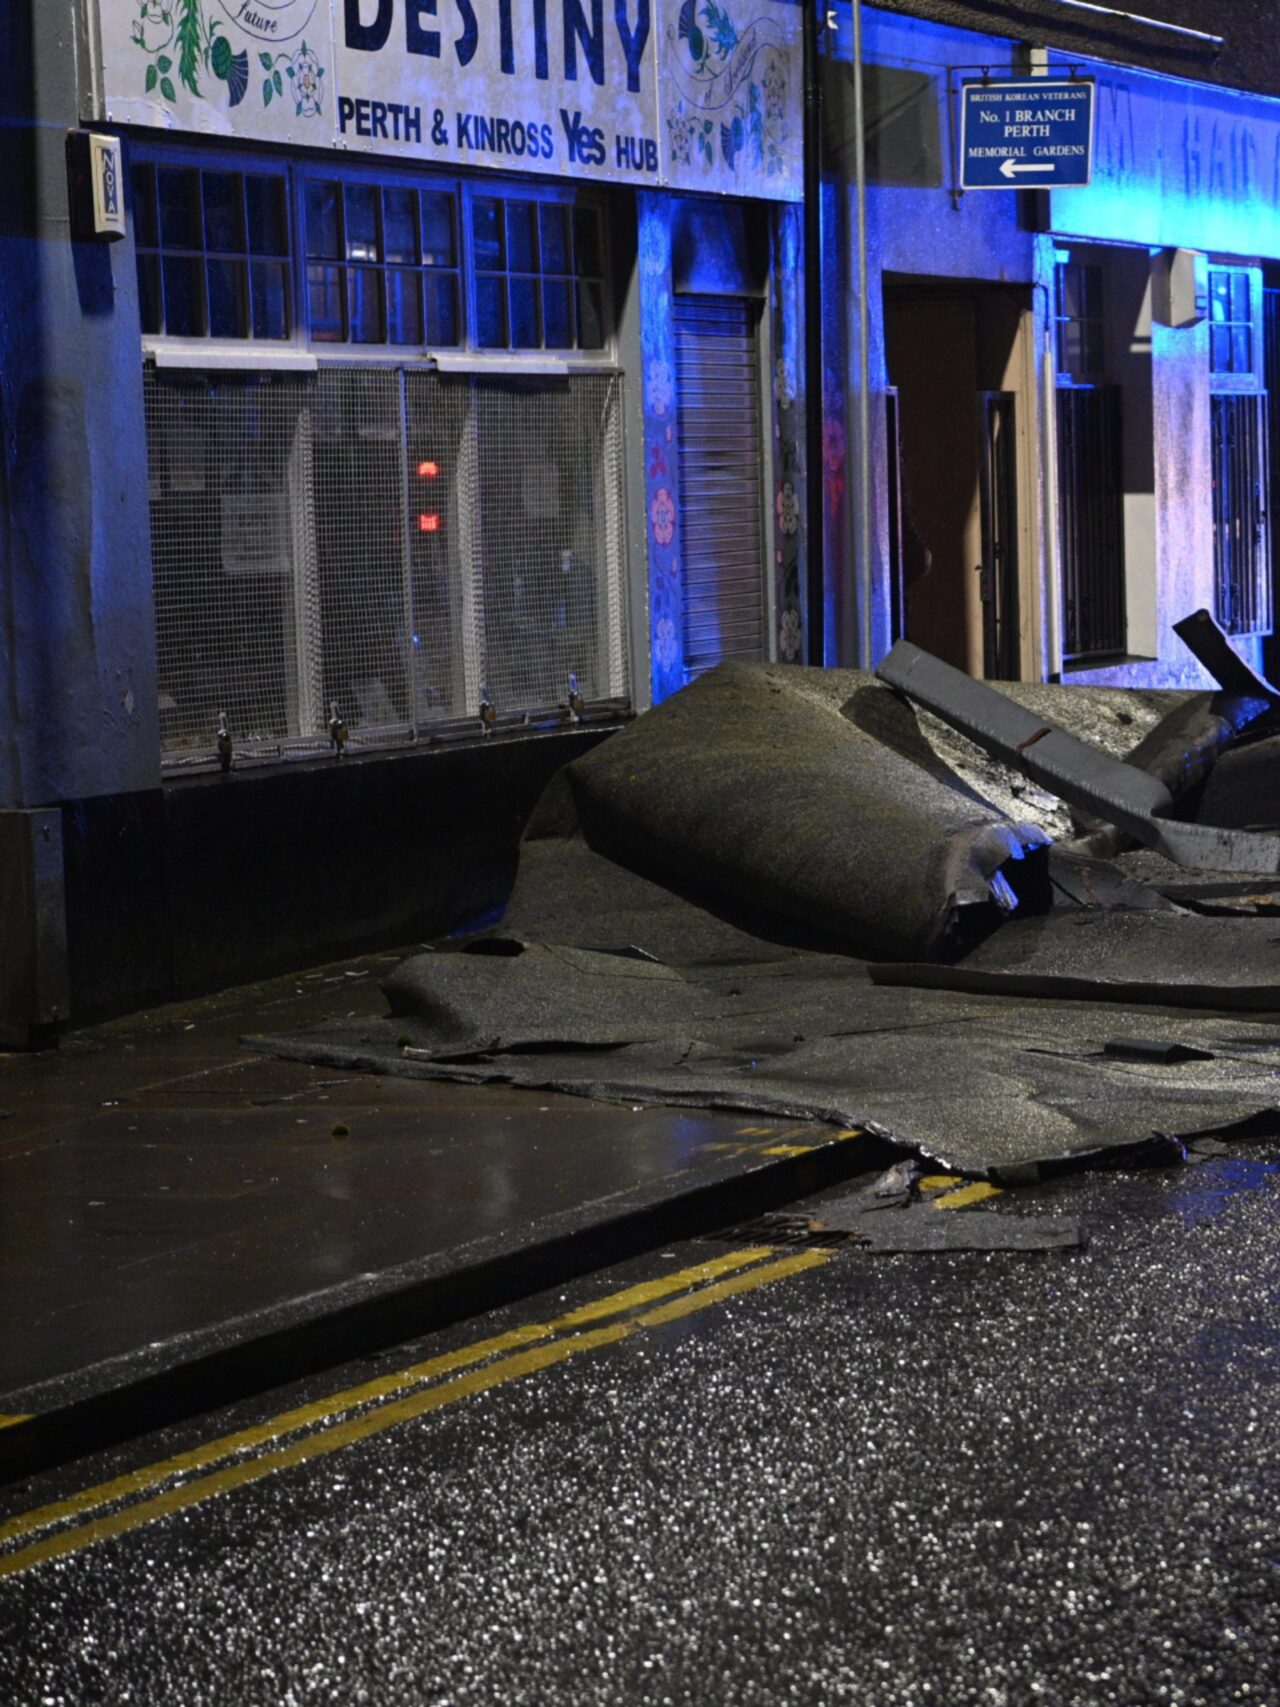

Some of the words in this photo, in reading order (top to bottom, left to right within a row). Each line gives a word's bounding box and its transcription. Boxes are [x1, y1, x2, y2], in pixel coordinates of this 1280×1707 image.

[970, 93, 1002, 102] BRITISH
[1005, 93, 1040, 101] KOREAN
[1042, 92, 1087, 100] VETERANS
[980, 110, 1000, 123] No.
[1005, 110, 1010, 122] 1
[1015, 109, 1076, 122] BRANCH
[338, 96, 422, 143] PERTH
[431, 108, 448, 146] &
[456, 112, 554, 159] KINROSS
[559, 108, 606, 166] Yes
[615, 134, 659, 172] HUB
[1004, 124, 1051, 138] PERTH
[968, 146, 1027, 158] MEMORIAL
[1033, 145, 1085, 157] GARDENS
[102, 151, 116, 214] NOVA
